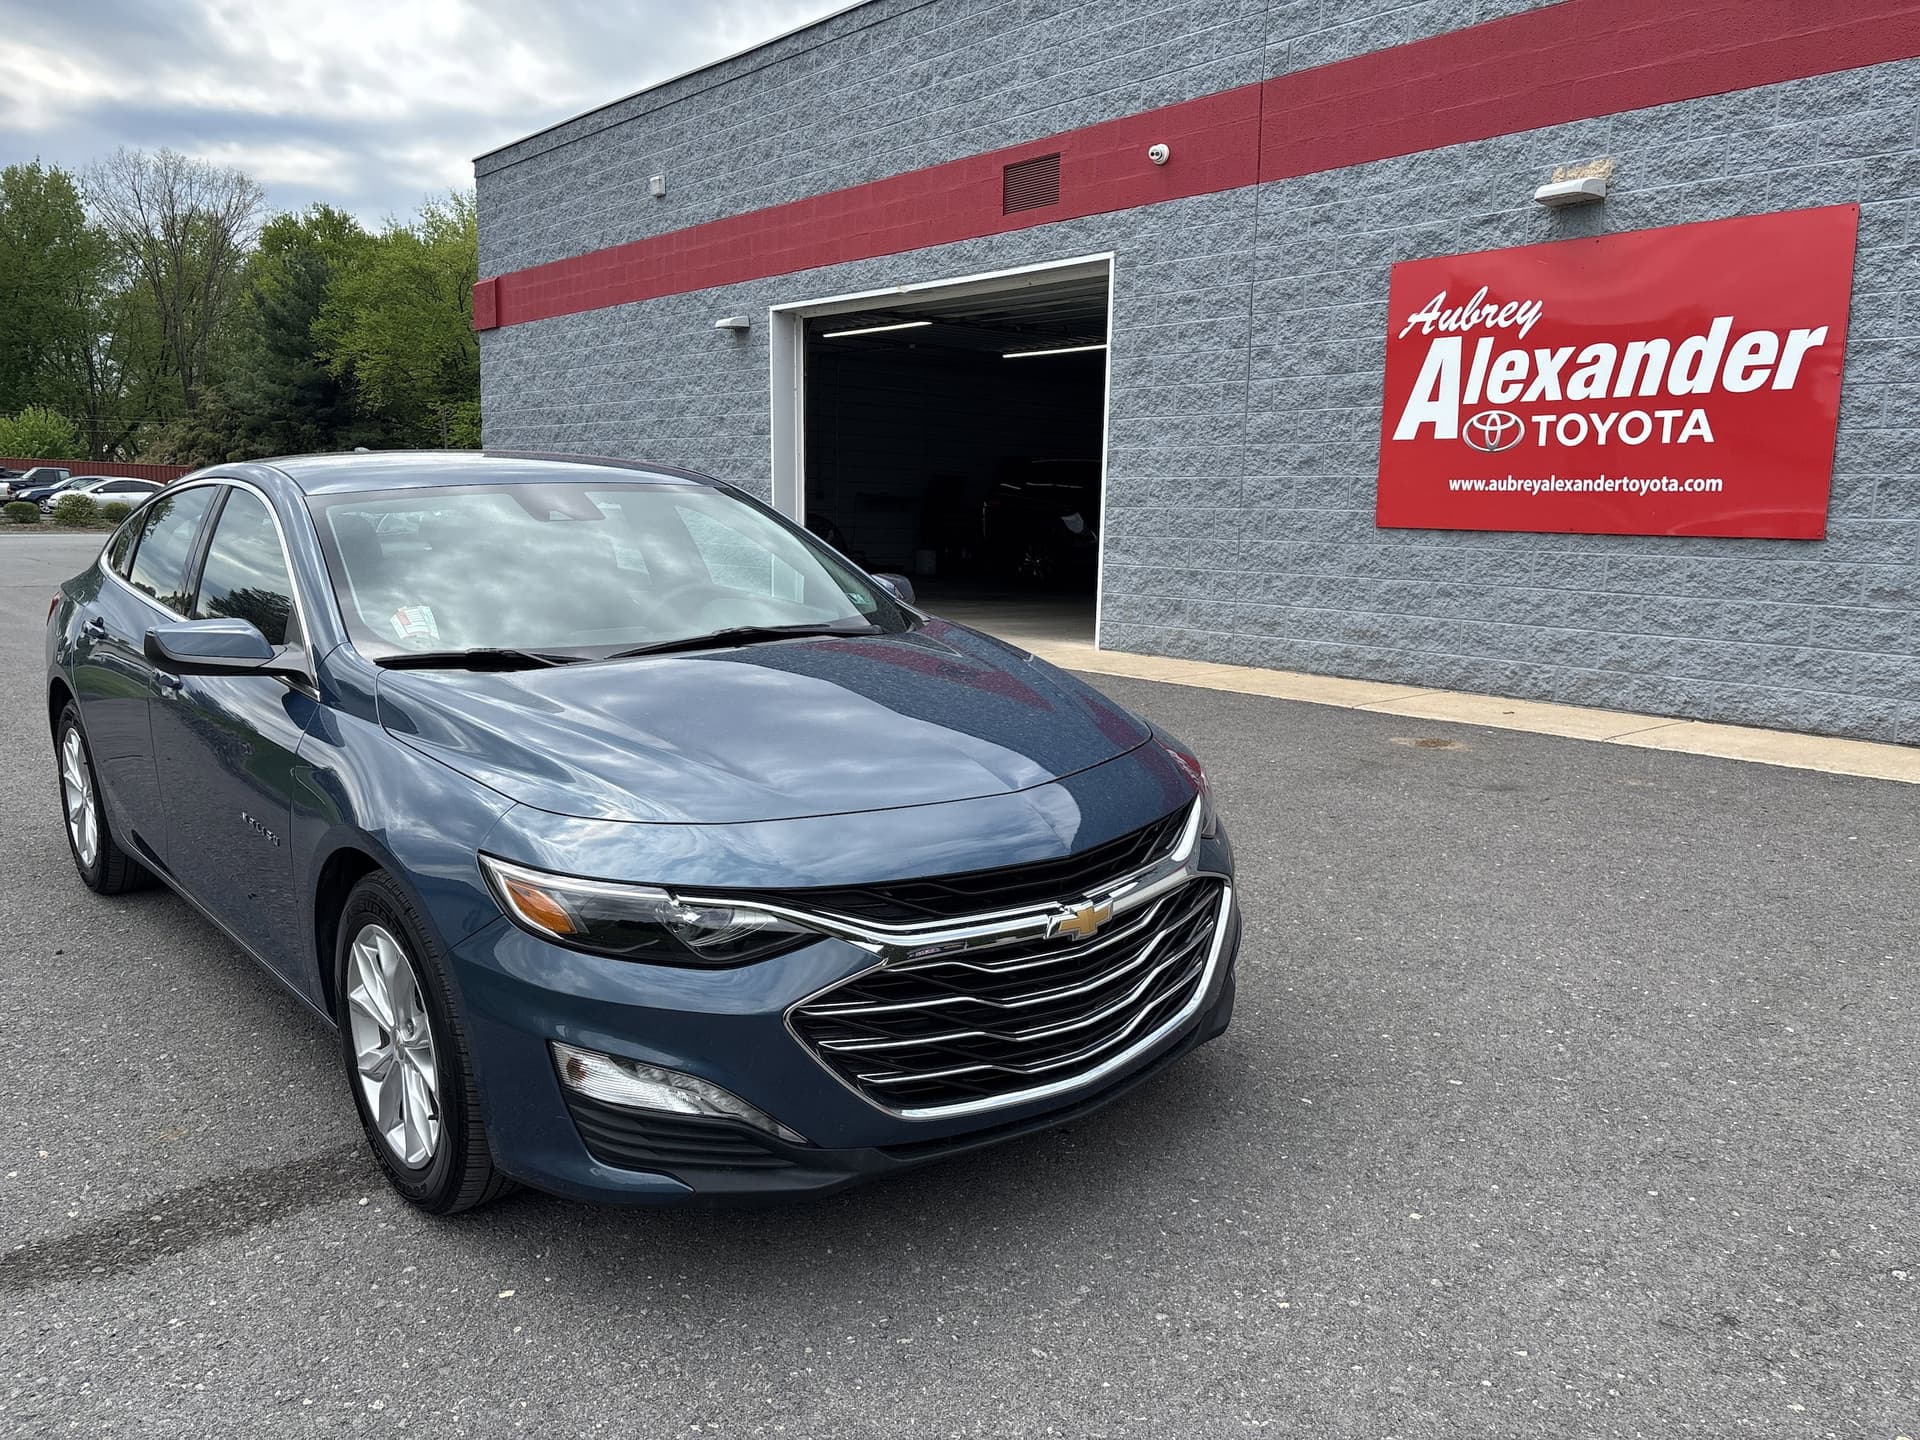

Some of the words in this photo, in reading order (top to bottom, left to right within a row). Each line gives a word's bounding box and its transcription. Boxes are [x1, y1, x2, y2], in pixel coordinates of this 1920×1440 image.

[1399, 285, 1543, 340] Aubrey
[1393, 316, 1828, 441] Alexander
[1532, 409, 1714, 446] TOYOTA
[1449, 474, 1723, 496] www.aubreyalexandertoyota.com
